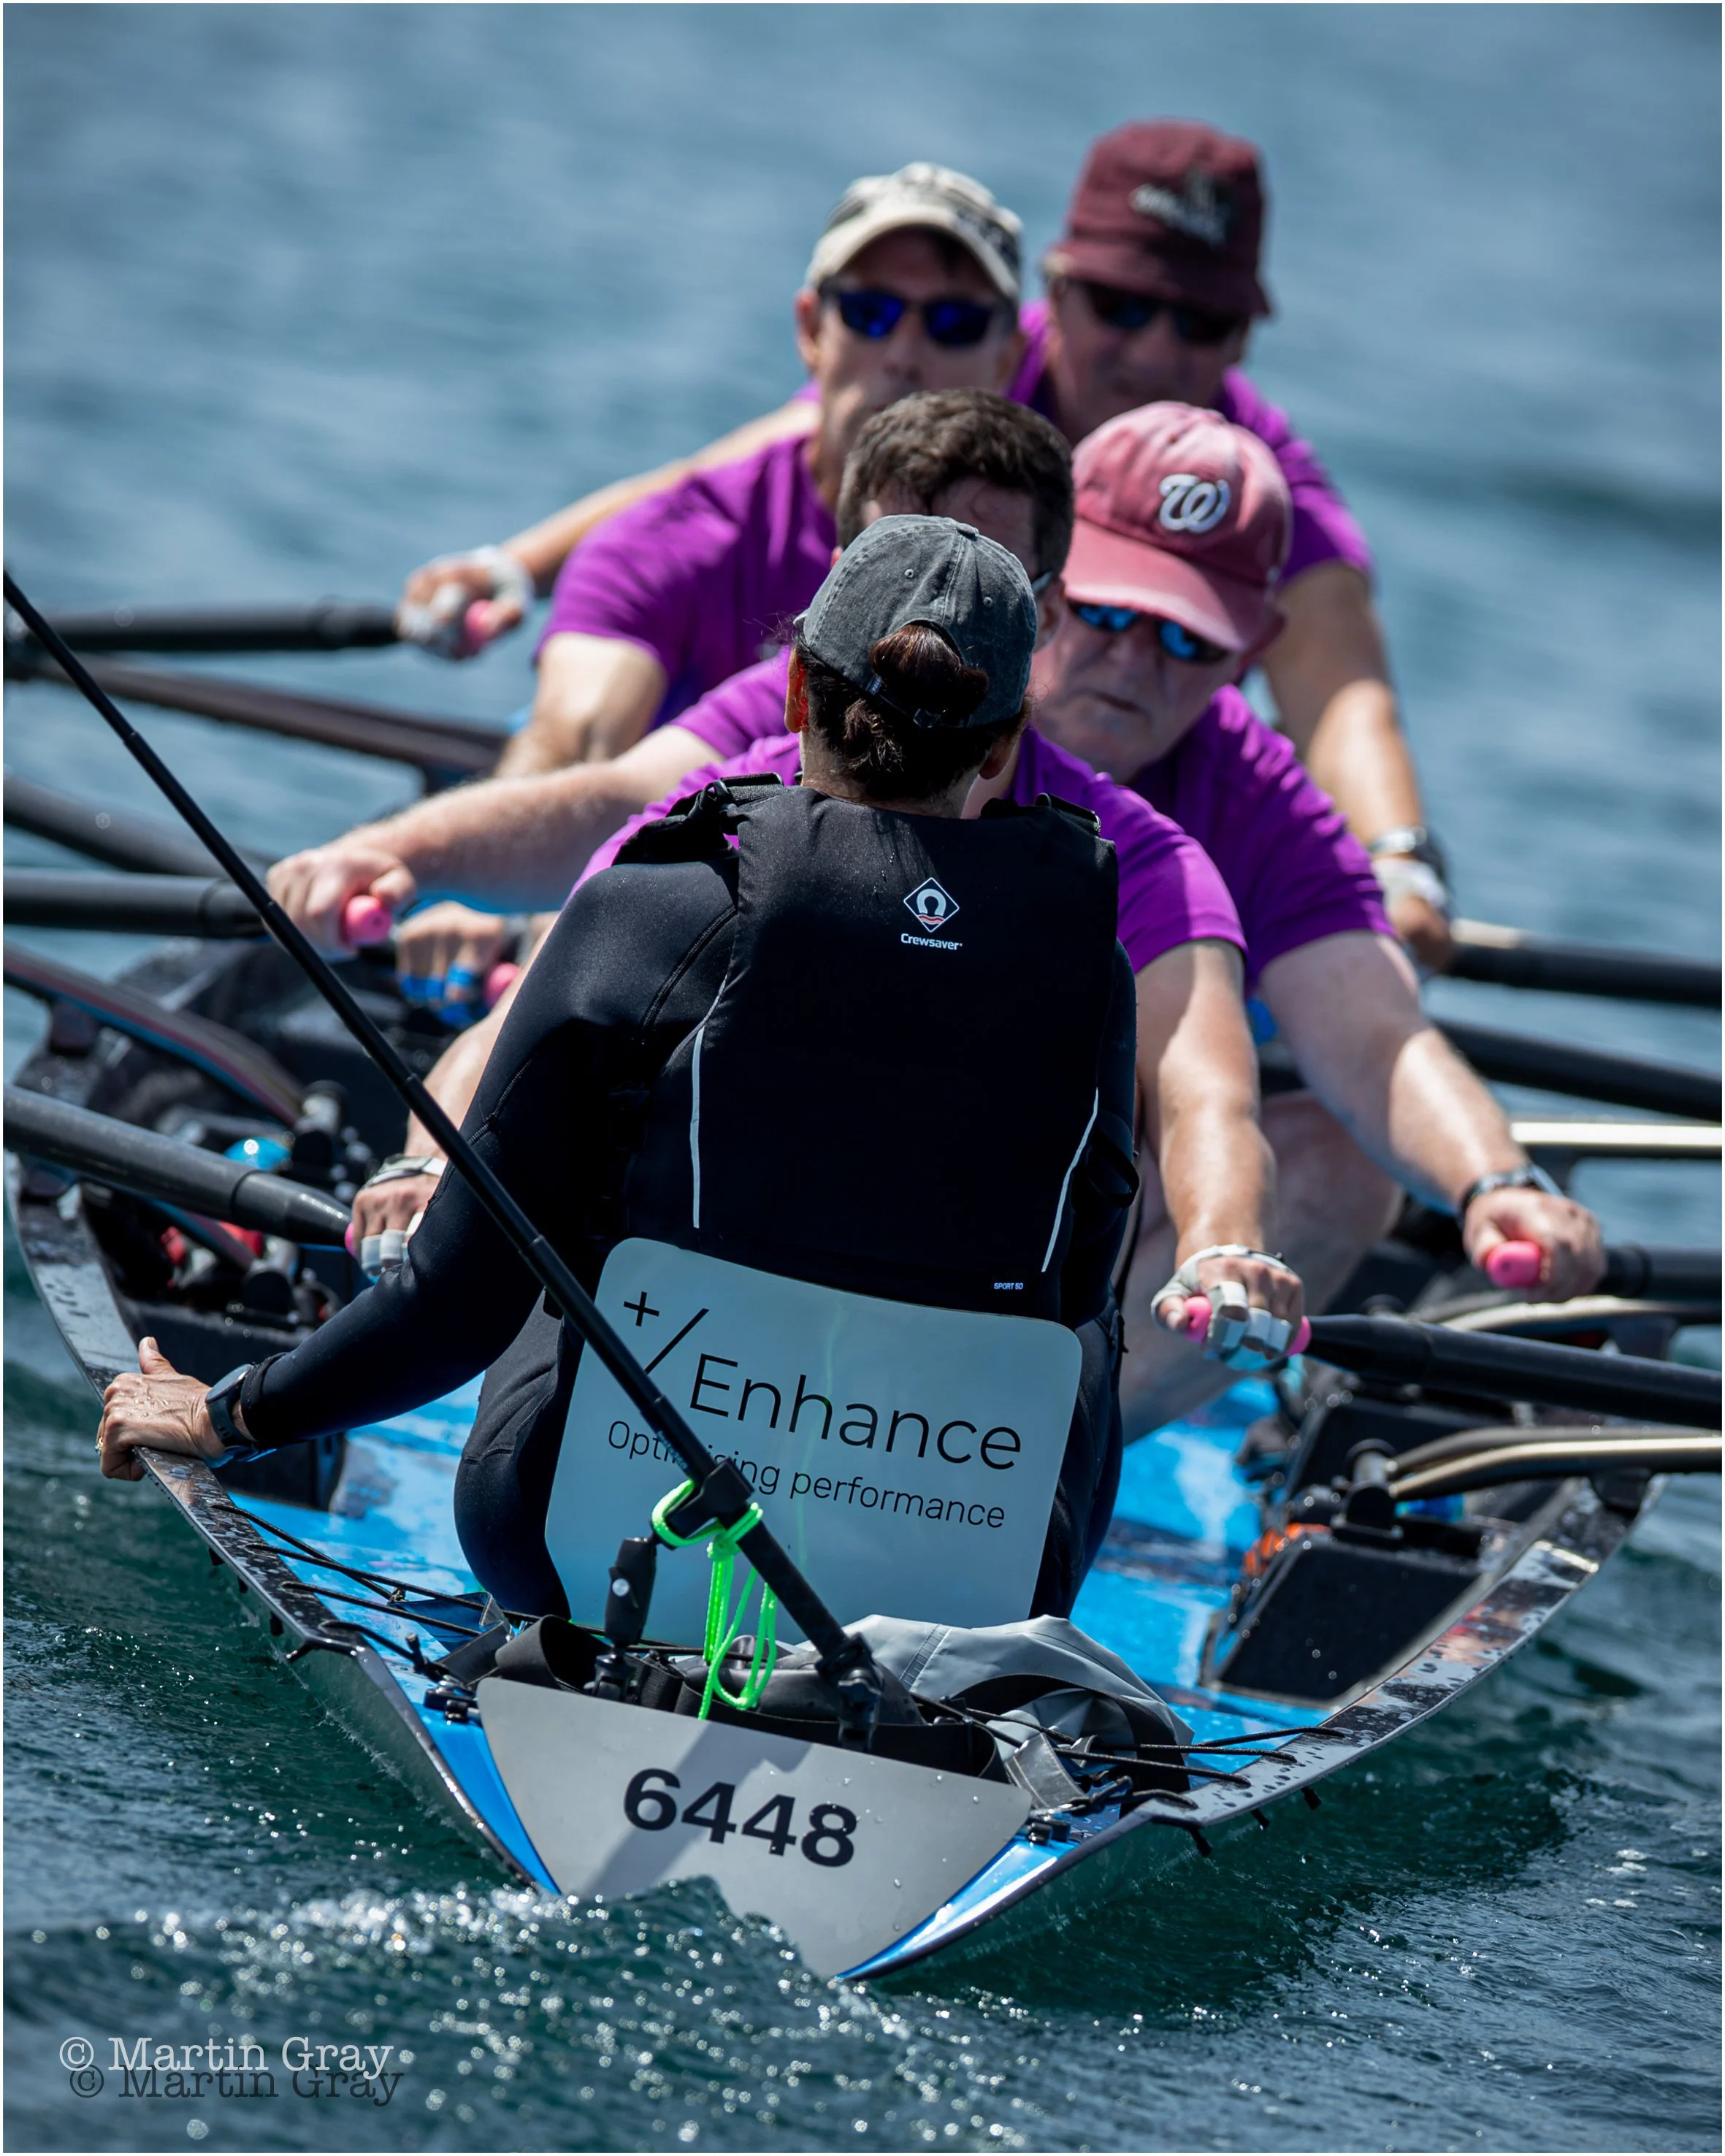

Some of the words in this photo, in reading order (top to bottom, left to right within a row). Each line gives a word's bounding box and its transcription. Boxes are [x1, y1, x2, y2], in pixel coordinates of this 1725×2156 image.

[1159, 473, 1231, 533] W
[900, 933, 959, 950] Crewsaver
[689, 1353, 1021, 1470] Enhance
[790, 1471, 1005, 1529] performance
[623, 1767, 857, 1868] 6448
